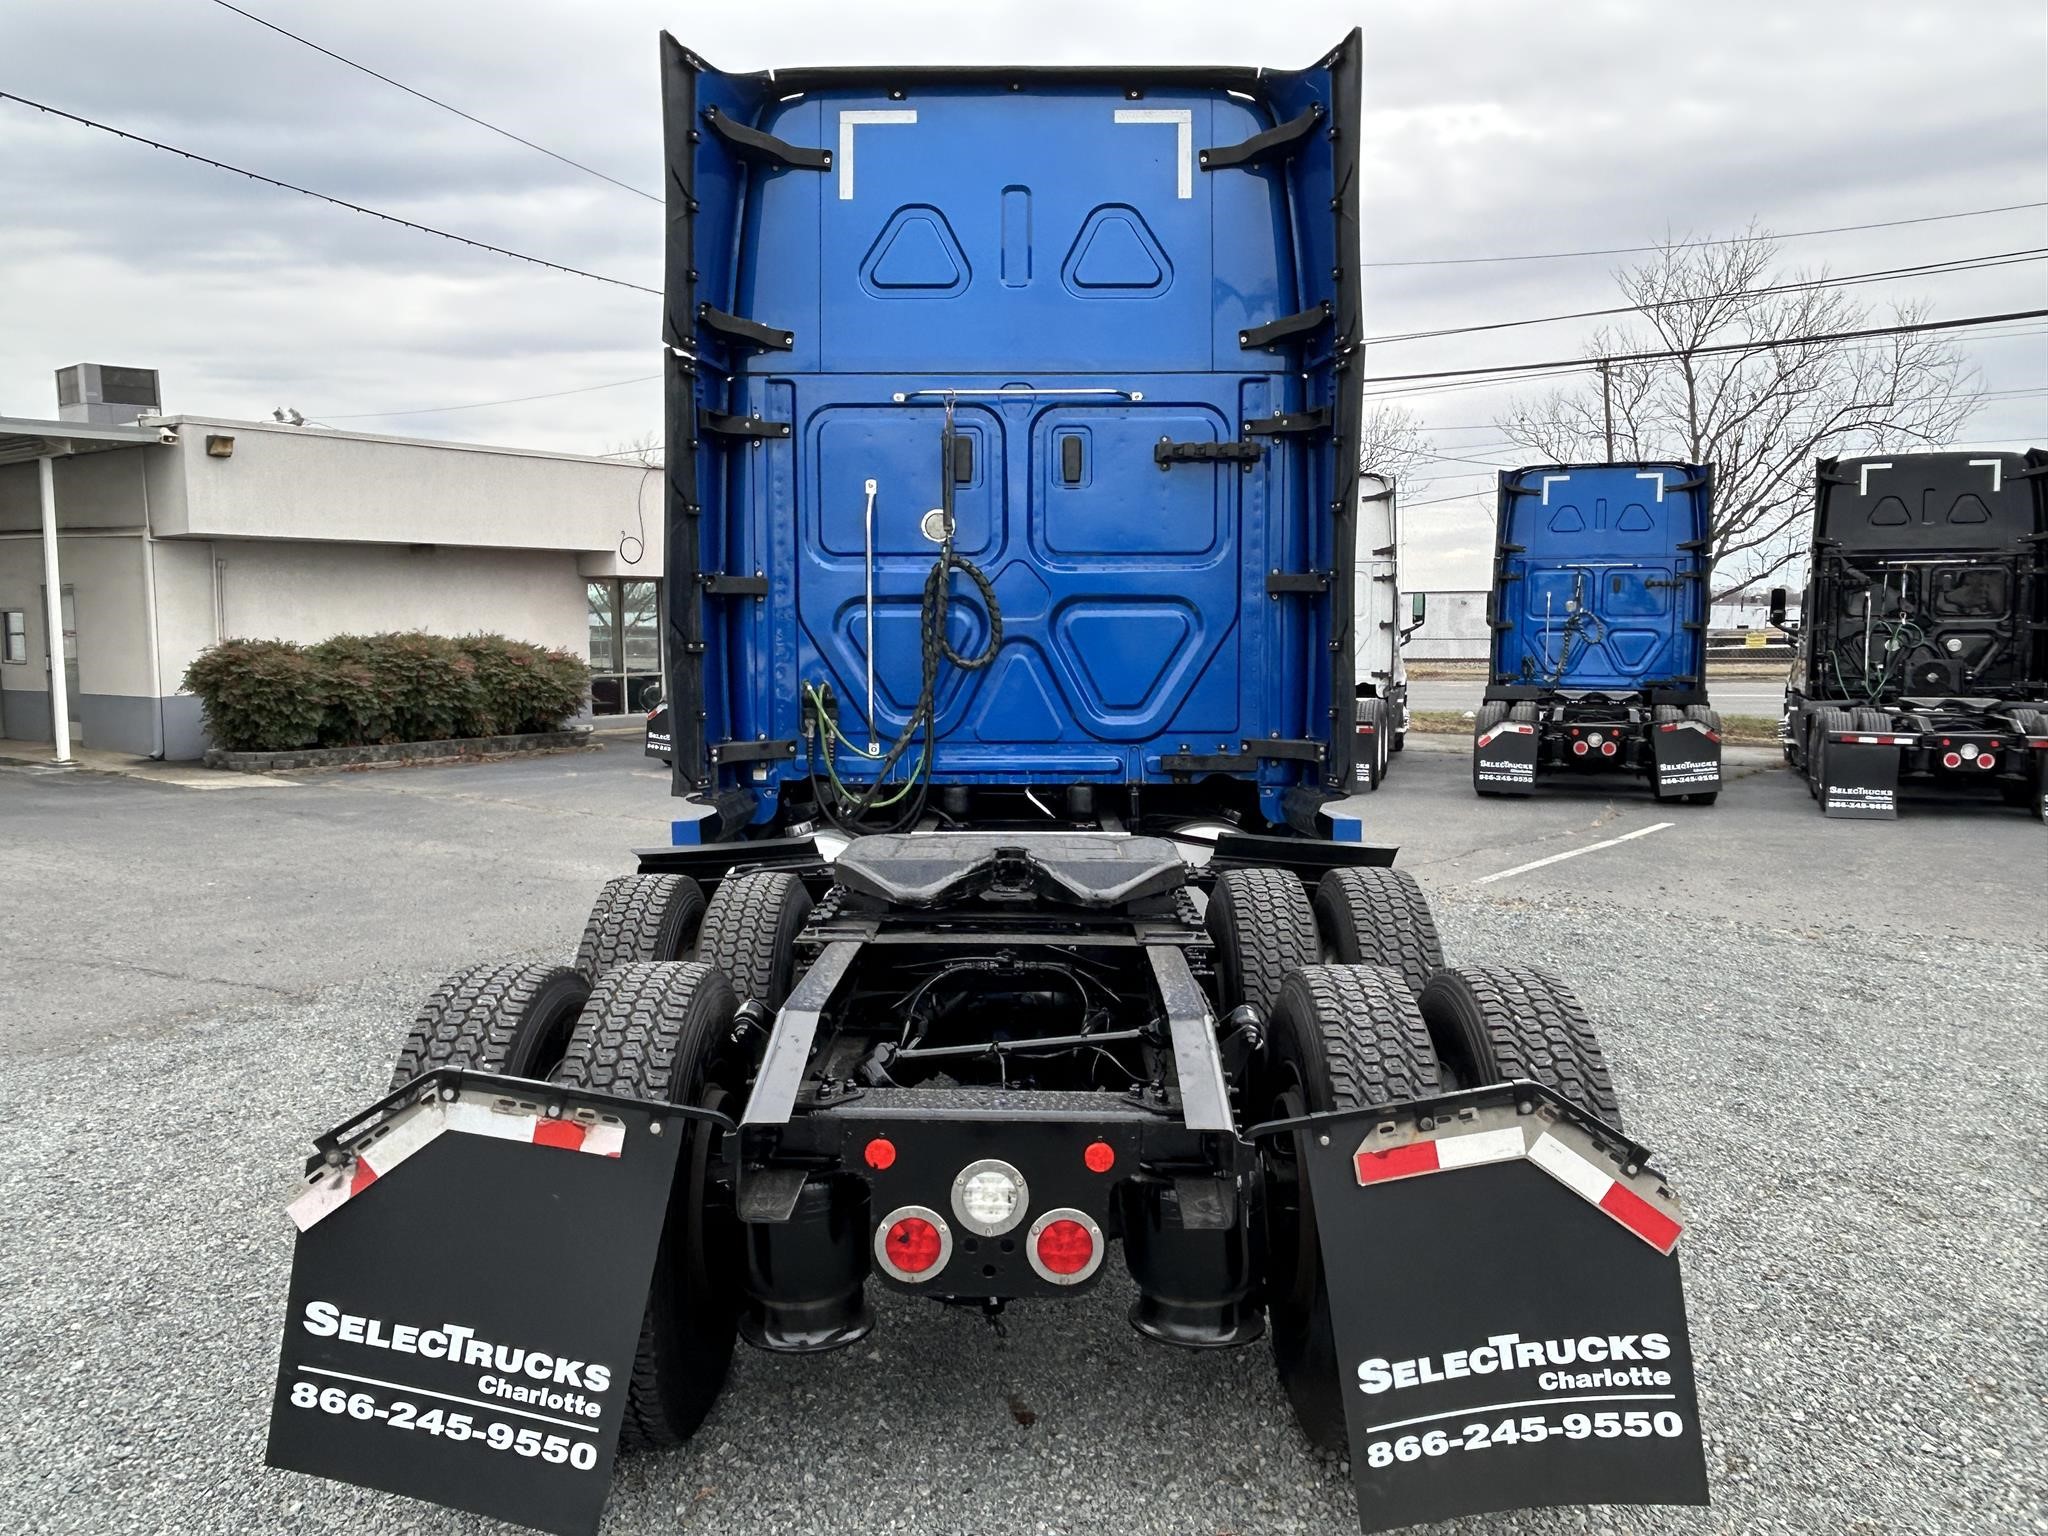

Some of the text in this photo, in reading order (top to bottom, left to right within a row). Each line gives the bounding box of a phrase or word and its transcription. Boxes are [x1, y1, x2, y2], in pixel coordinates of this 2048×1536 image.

[303, 1301, 611, 1392] SELECTRUCKS
[1357, 1333, 1671, 1395] SELECTRUCKS
[477, 1374, 602, 1418] Charlotte
[1538, 1366, 1672, 1391] Charlotte
[290, 1381, 598, 1471] 866-245-9550
[1367, 1410, 1684, 1468] 866-245-9550
